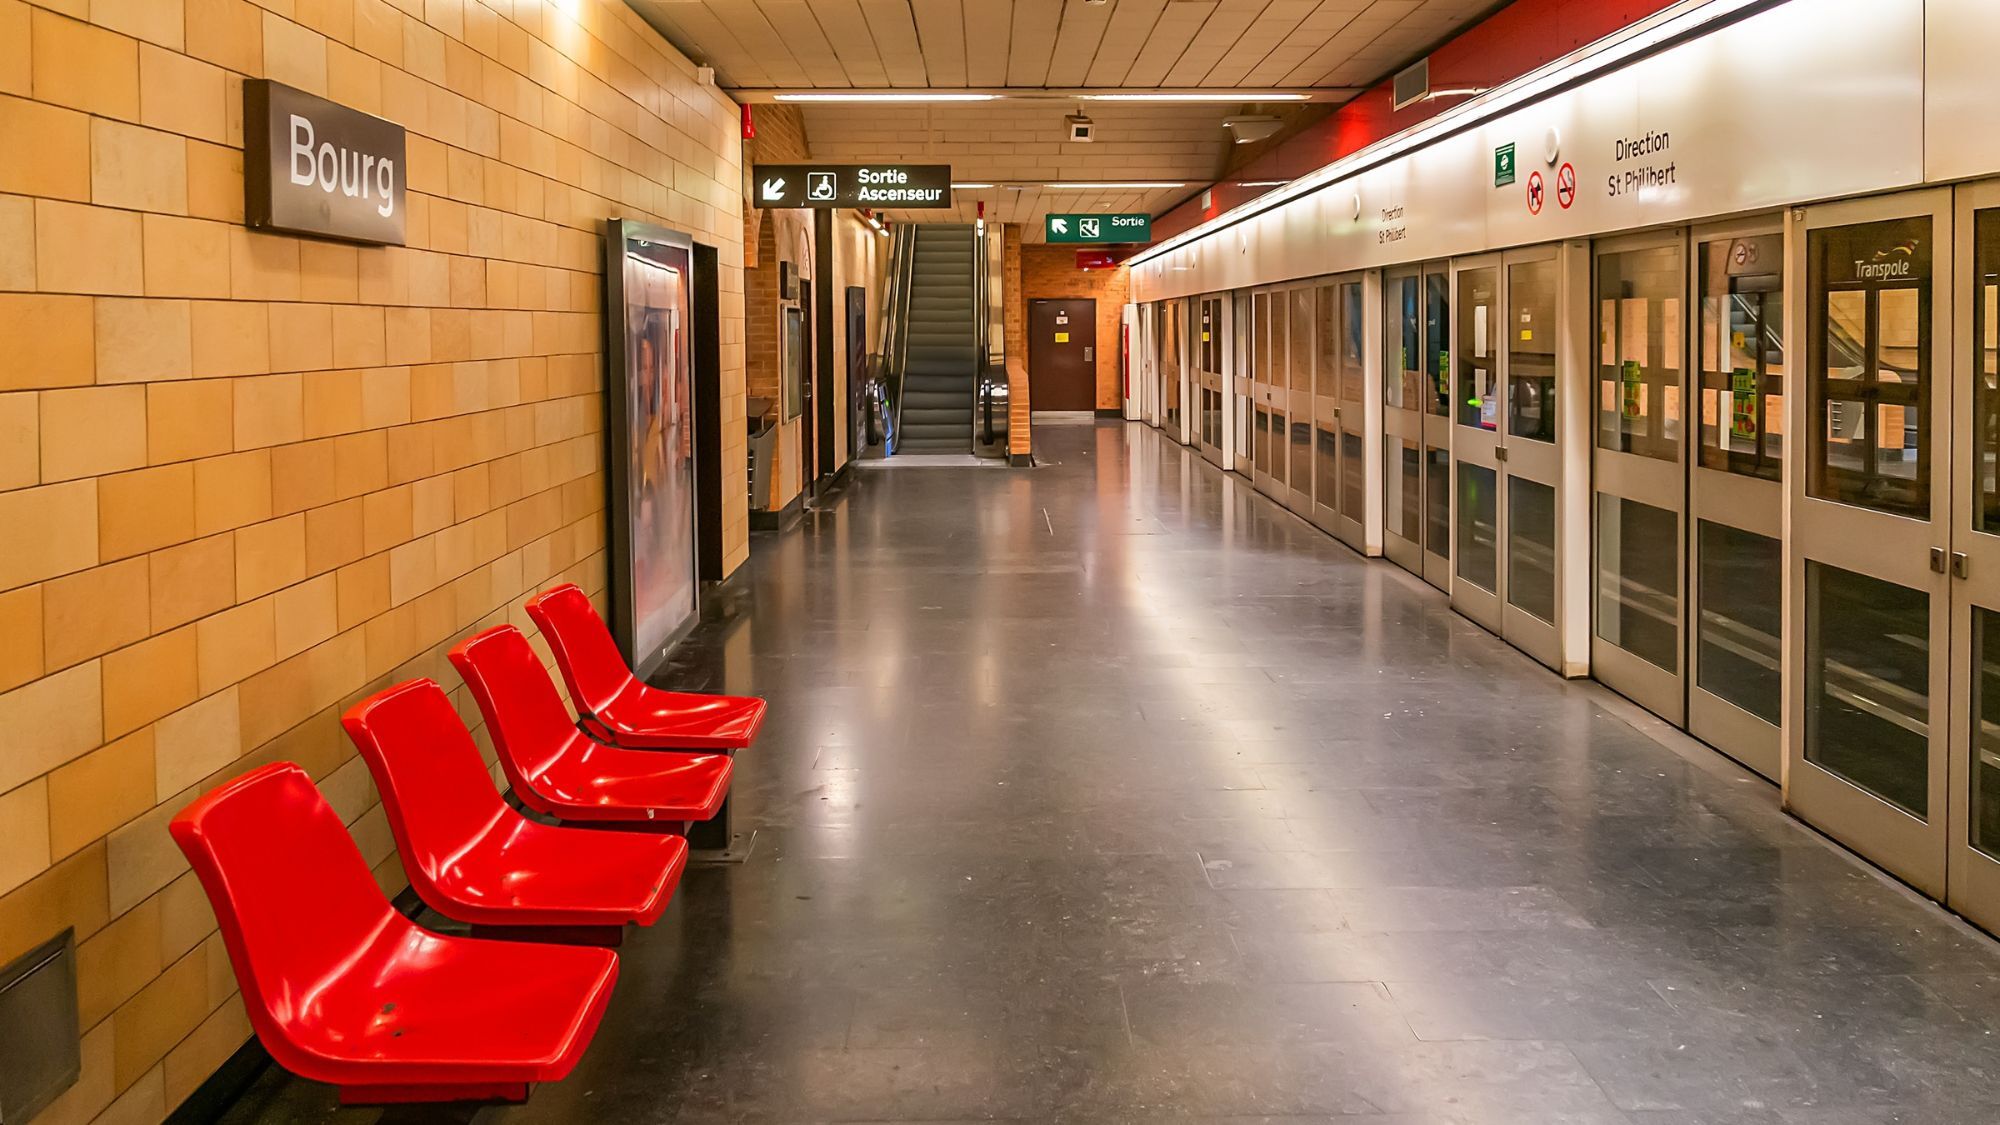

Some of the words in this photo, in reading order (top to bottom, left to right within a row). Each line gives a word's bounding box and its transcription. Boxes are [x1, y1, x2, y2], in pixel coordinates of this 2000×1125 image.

[1616, 130, 1669, 161] Direction
[290, 114, 393, 217] Bourg
[858, 168, 908, 184] Sortie
[1608, 174, 1621, 197] St
[1625, 161, 1676, 194] Philibert
[858, 186, 942, 201] Ascenseur
[1111, 216, 1145, 226] Sortie
[1382, 205, 1403, 222] Direction
[1855, 259, 1910, 281] Transpole
